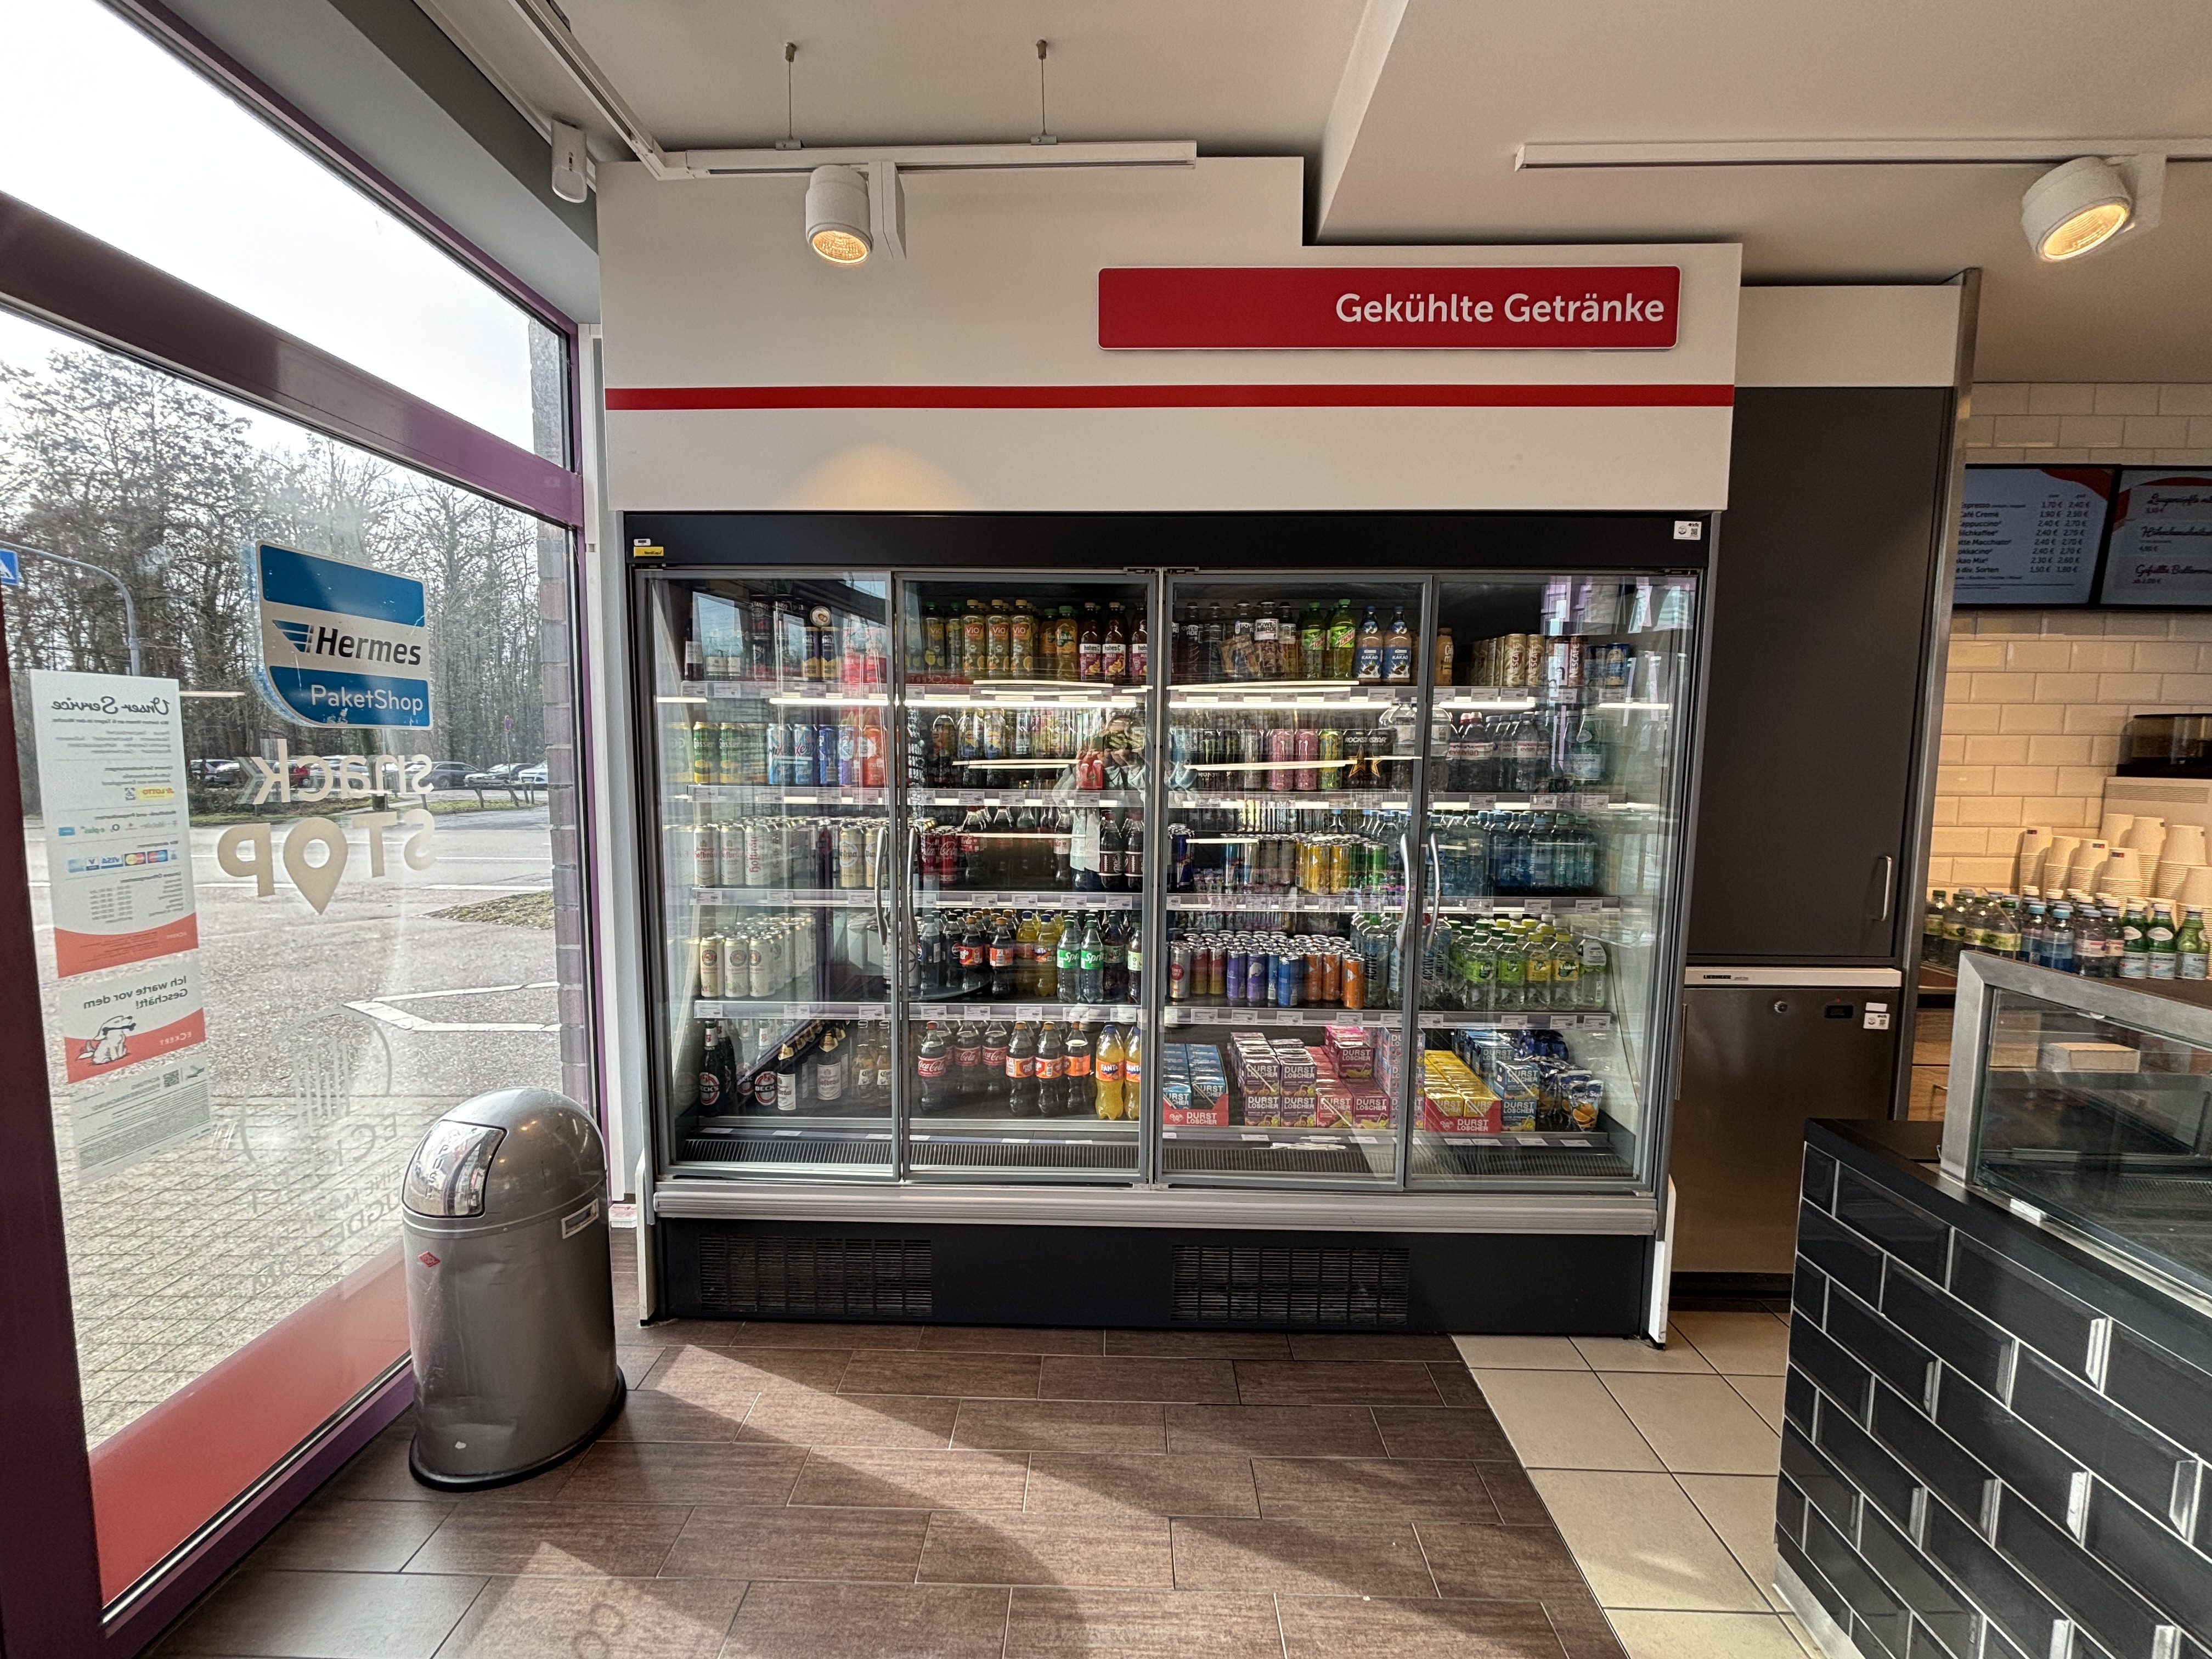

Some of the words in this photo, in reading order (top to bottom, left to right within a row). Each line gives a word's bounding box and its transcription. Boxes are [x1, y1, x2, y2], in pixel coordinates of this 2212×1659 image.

[1336, 294, 1493, 322] Gekühlte
[1504, 293, 1664, 322] Getränke
[316, 627, 421, 665] Hermes
[312, 685, 424, 715] PaketShop
[1365, 952, 1378, 980] ACTIVE
